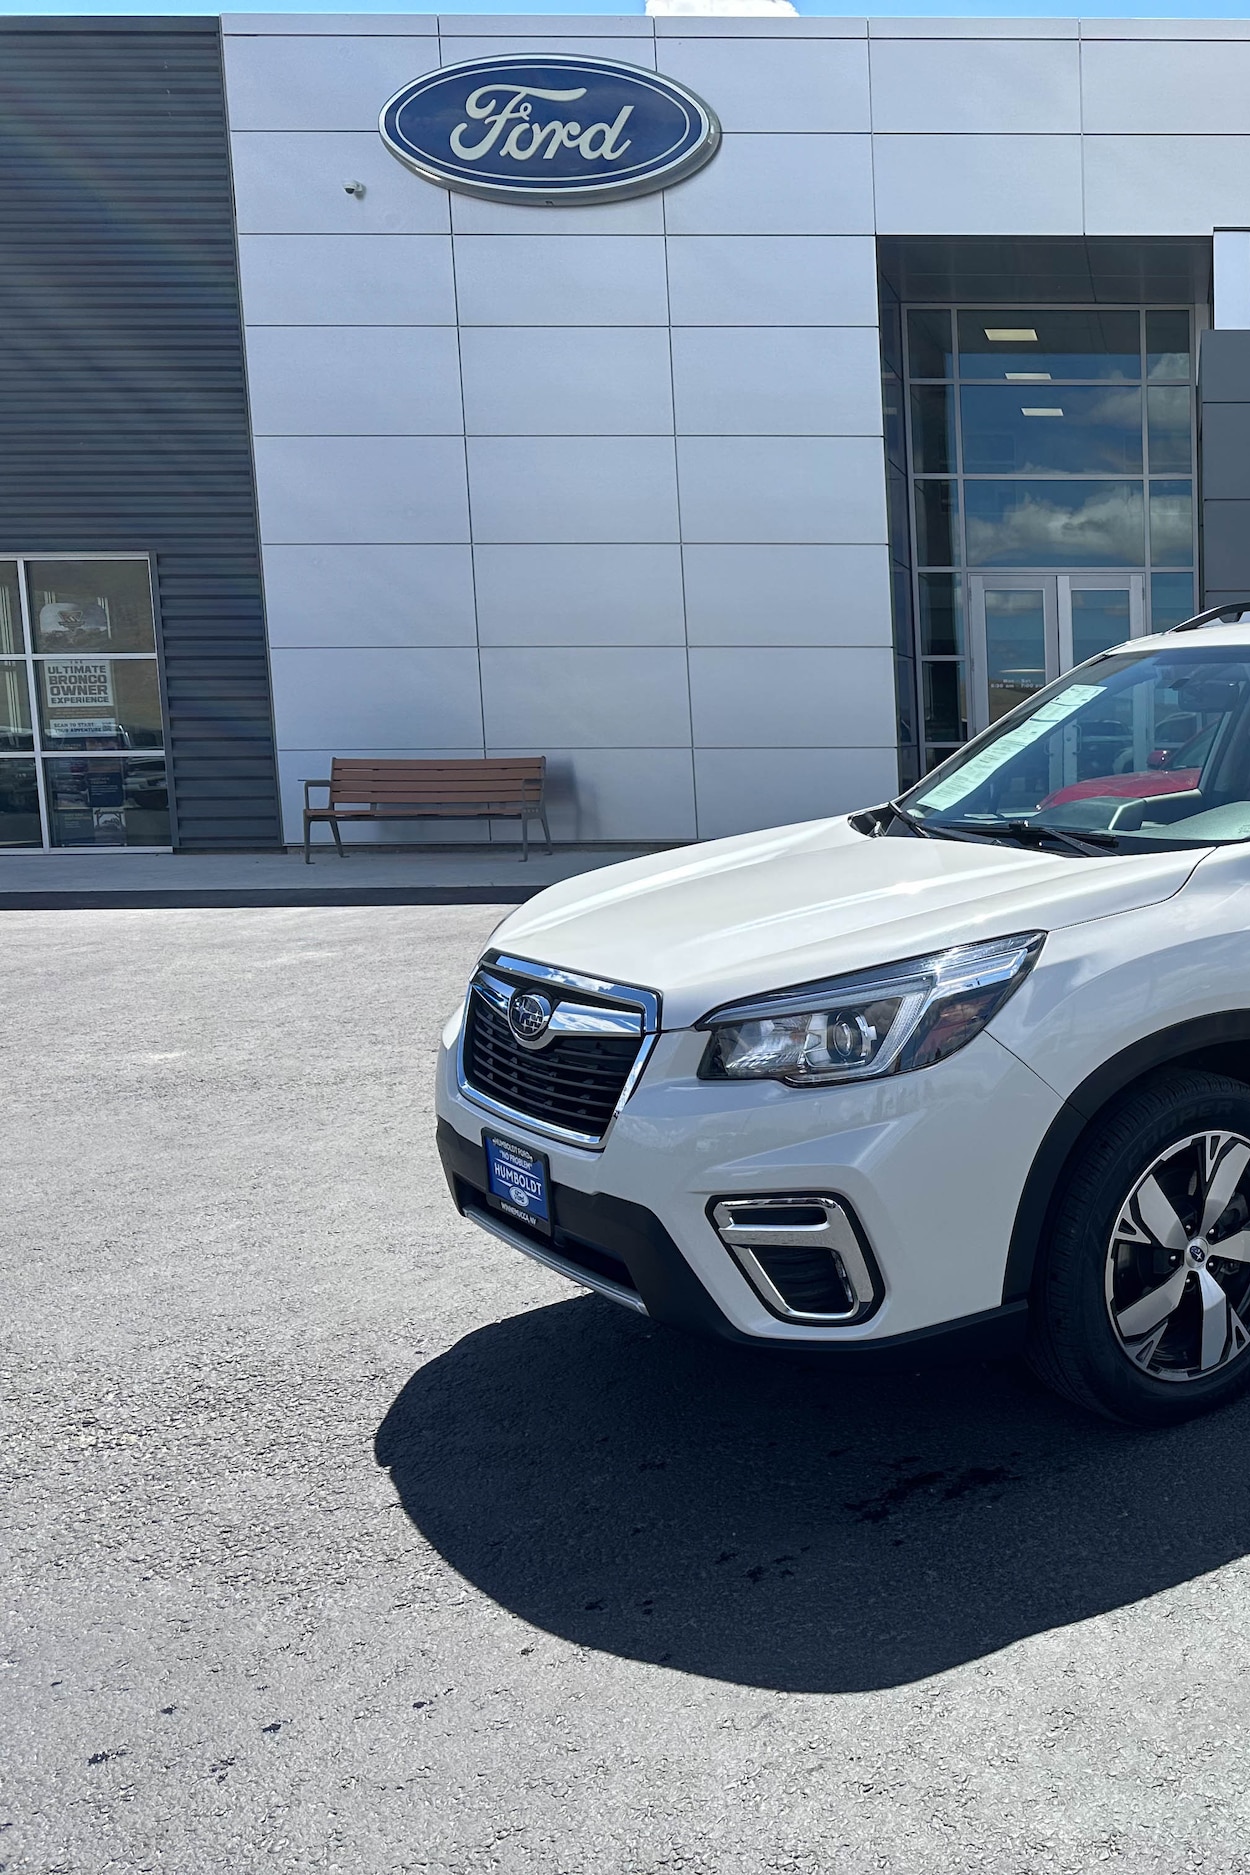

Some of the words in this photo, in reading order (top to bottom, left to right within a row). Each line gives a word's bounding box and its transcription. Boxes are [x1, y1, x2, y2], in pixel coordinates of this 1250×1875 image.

[450, 83, 635, 161] Ford
[47, 665, 107, 674] ULTIMATE
[48, 674, 107, 685] BRONCO
[49, 685, 108, 696] OWNER
[51, 696, 109, 704] EXPERIENCE
[494, 1162, 542, 1195] HUMBOLDT
